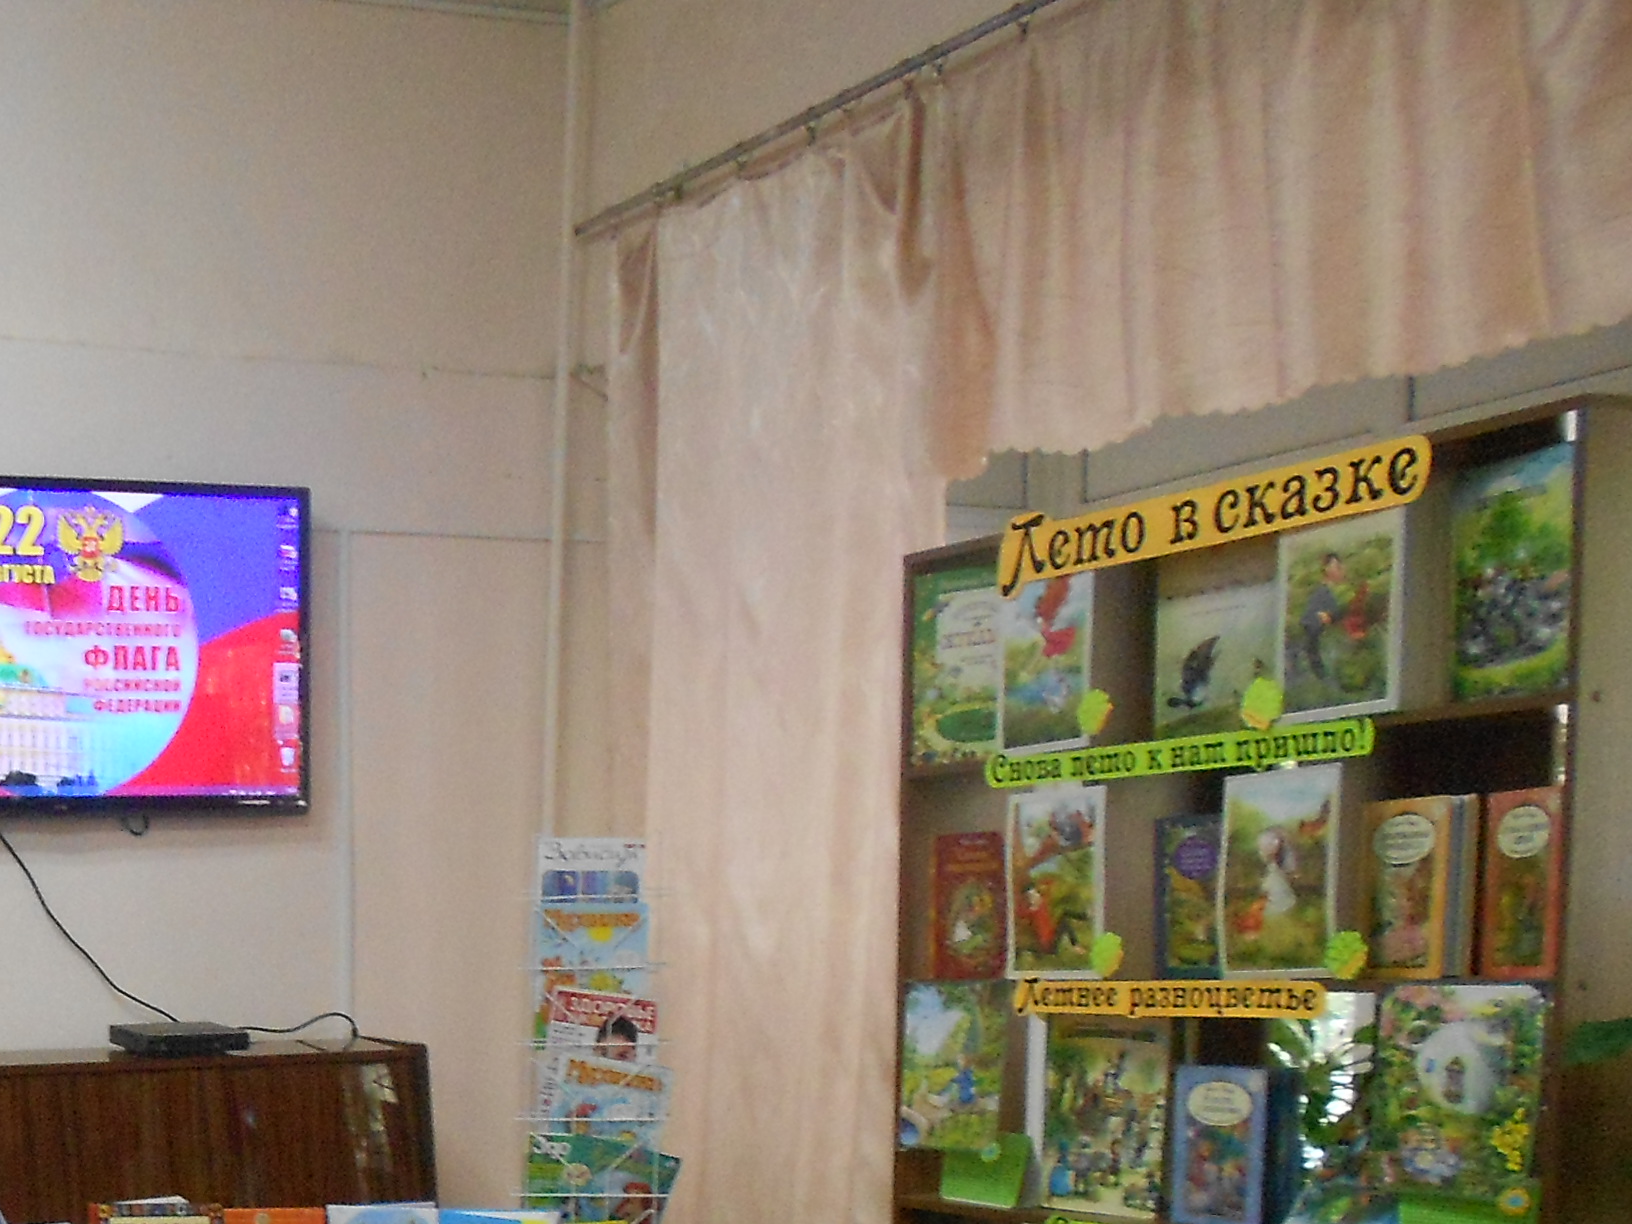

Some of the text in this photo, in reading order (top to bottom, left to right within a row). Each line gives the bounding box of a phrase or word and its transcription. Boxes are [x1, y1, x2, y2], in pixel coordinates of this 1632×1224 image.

[1001, 445, 1420, 597] Лето в сказке
[106, 585, 180, 613] ДЕНЬ
[25, 620, 182, 637] ГОСУДАРСТВЕННОГО
[84, 645, 180, 671] ФЛАГА
[93, 699, 182, 713] ФЕДЕРАЦИИ
[992, 719, 1367, 784] Снова лето к нам пришло!
[1016, 977, 1318, 1016] Летнее разноцветье
